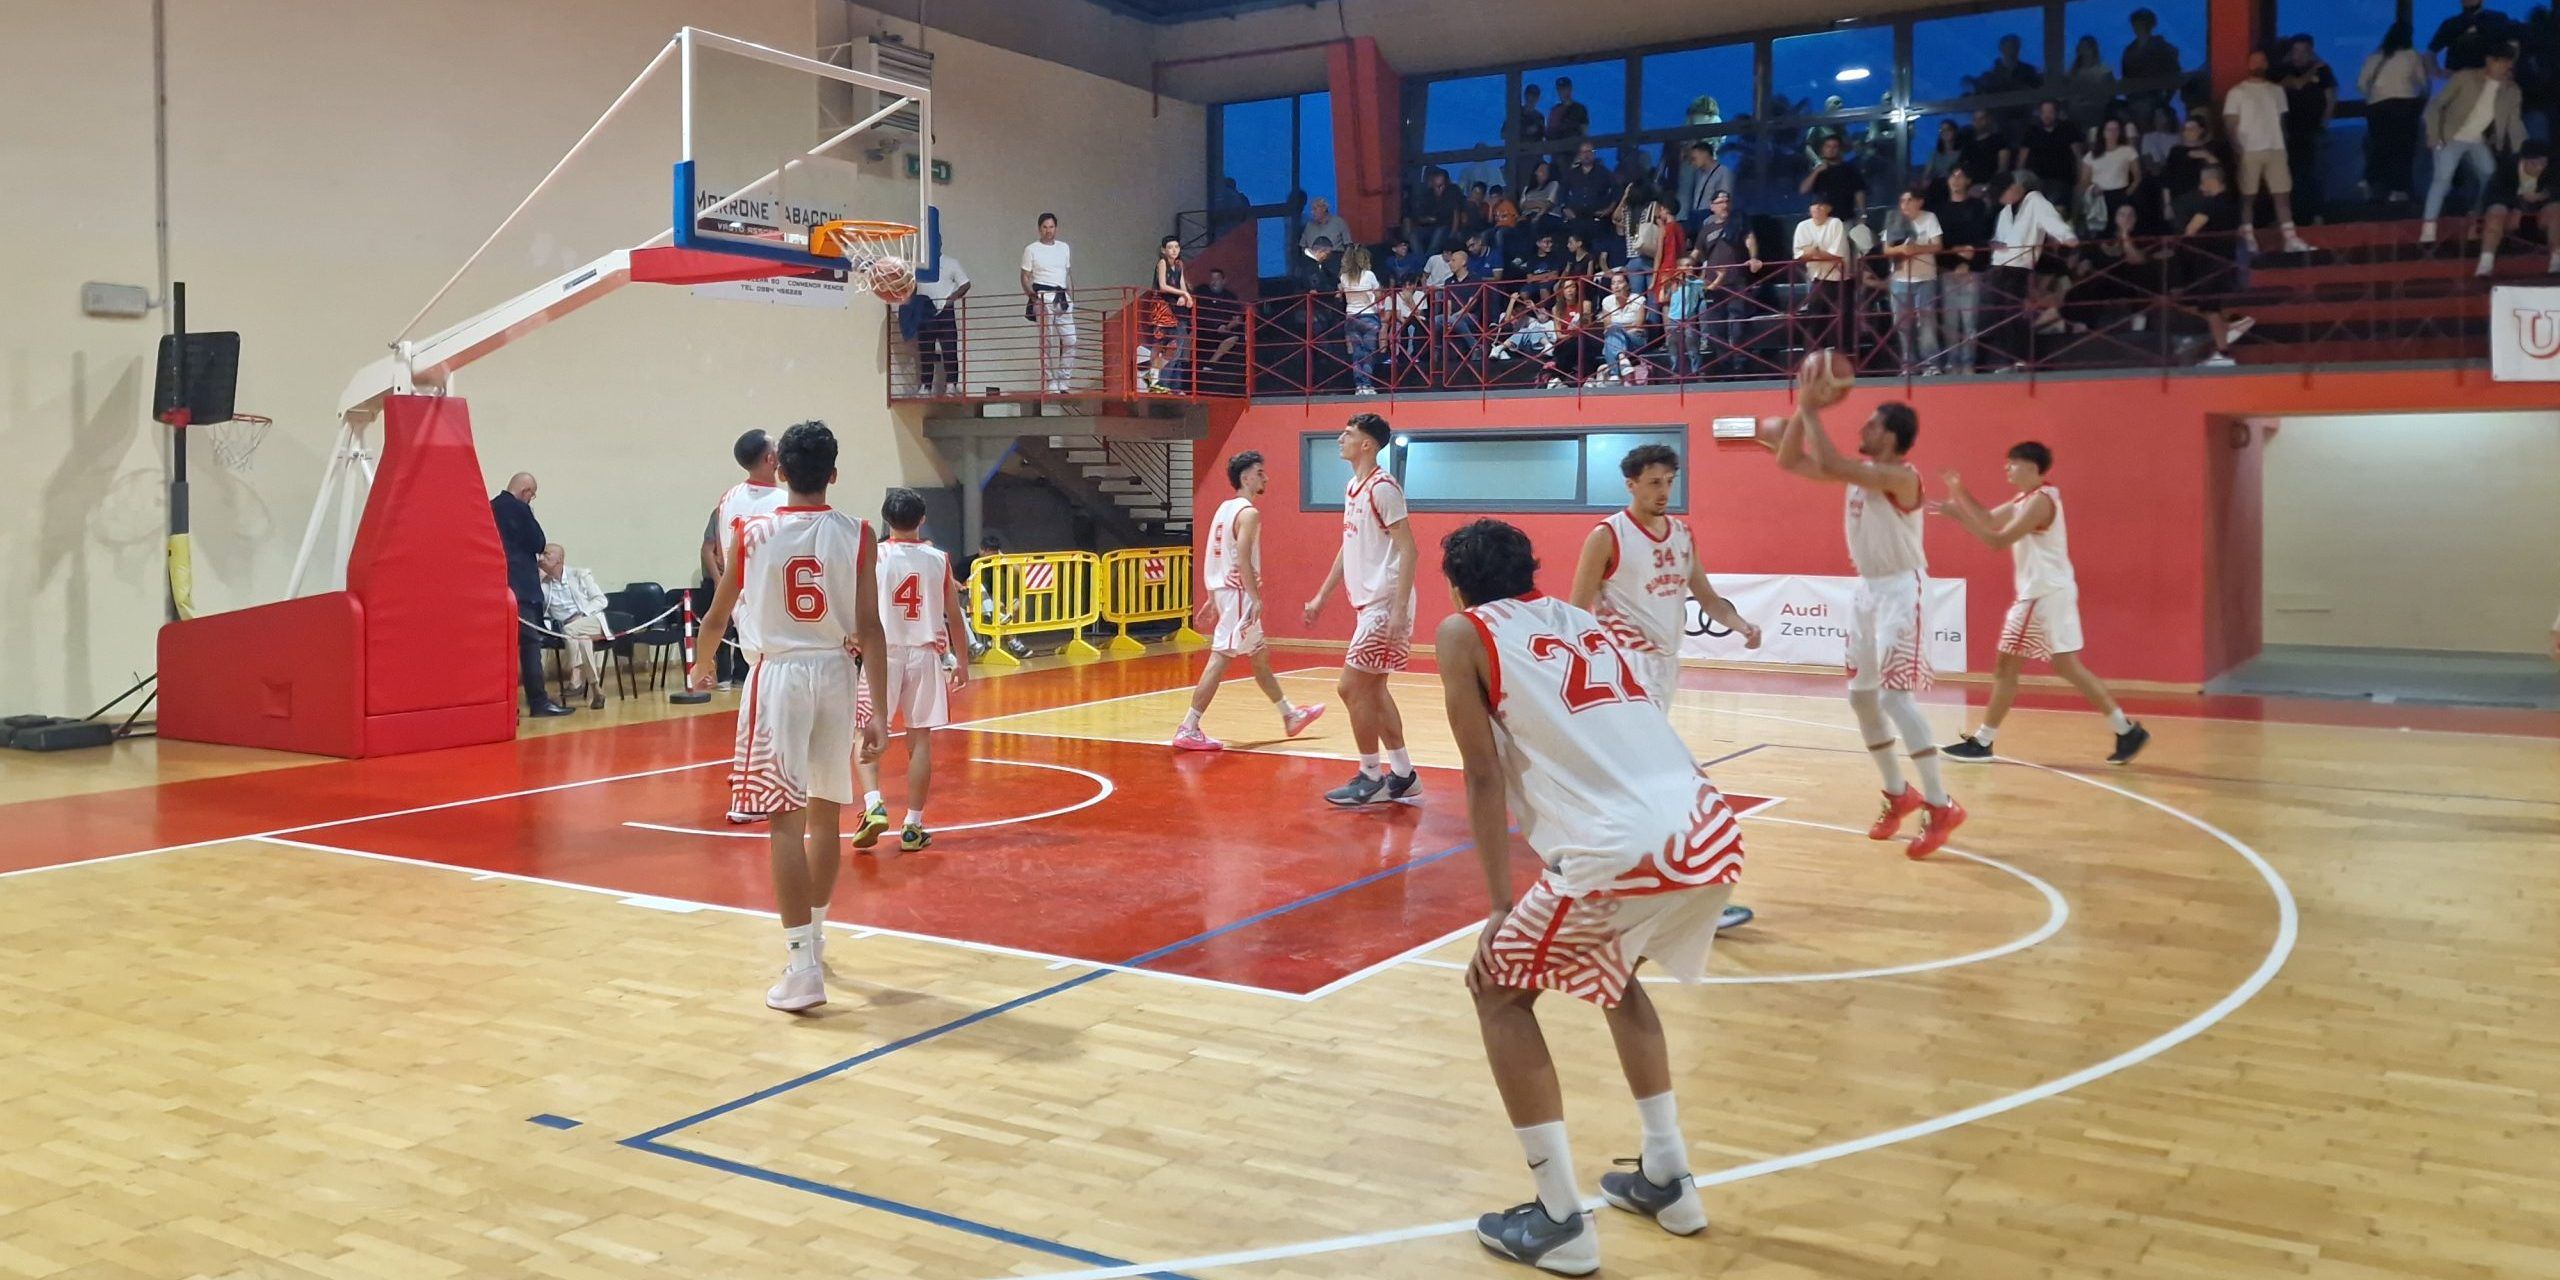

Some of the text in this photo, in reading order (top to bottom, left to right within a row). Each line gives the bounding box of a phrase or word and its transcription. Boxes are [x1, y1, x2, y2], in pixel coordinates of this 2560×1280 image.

[775, 201, 842, 226] ABACCHI
[1653, 547, 1676, 569] 34
[783, 556, 828, 622] 6
[892, 572, 923, 621] 4
[1781, 603, 1828, 617] Audi
[1780, 622, 1849, 638] Zentru
[1527, 629, 1652, 715] 22
